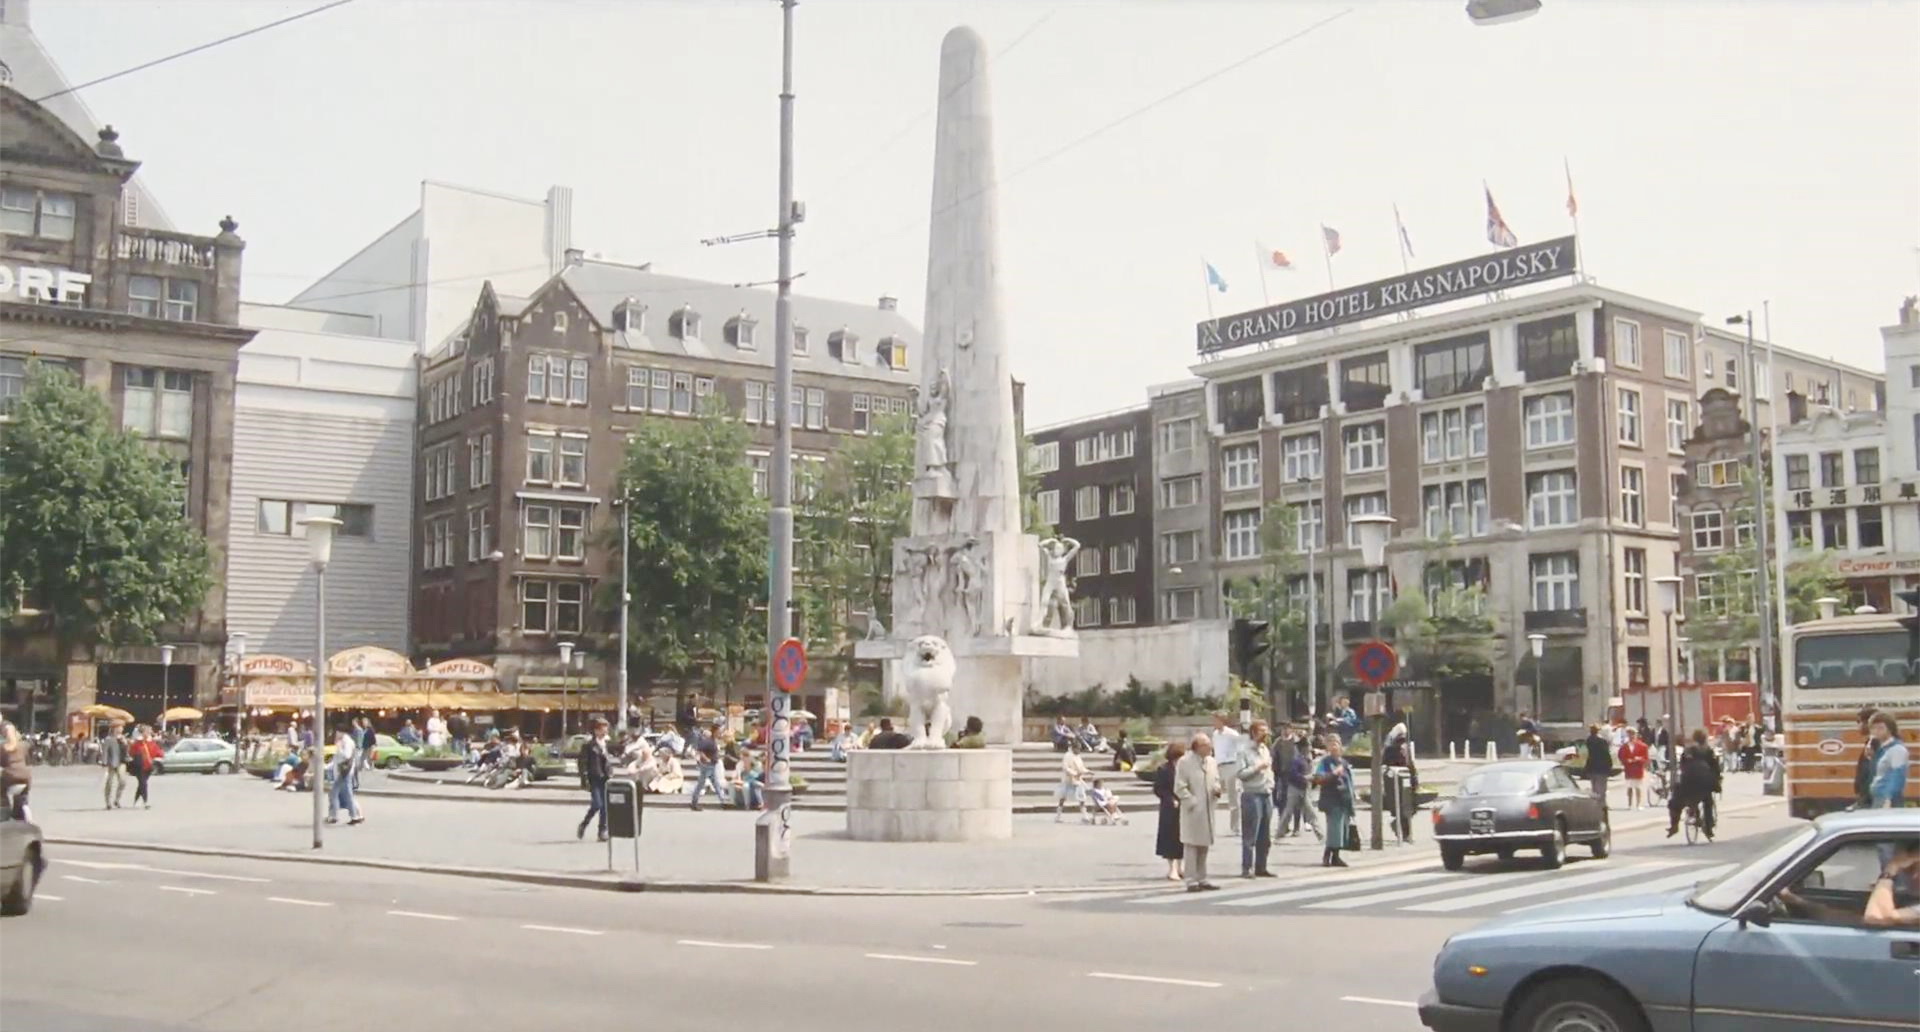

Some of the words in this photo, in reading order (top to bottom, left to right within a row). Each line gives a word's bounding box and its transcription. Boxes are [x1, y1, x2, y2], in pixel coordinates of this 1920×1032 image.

[1228, 308, 1297, 341] GRAND
[1305, 291, 1375, 324] HOTEL
[1381, 246, 1561, 307] KRASNAPOLSKY
